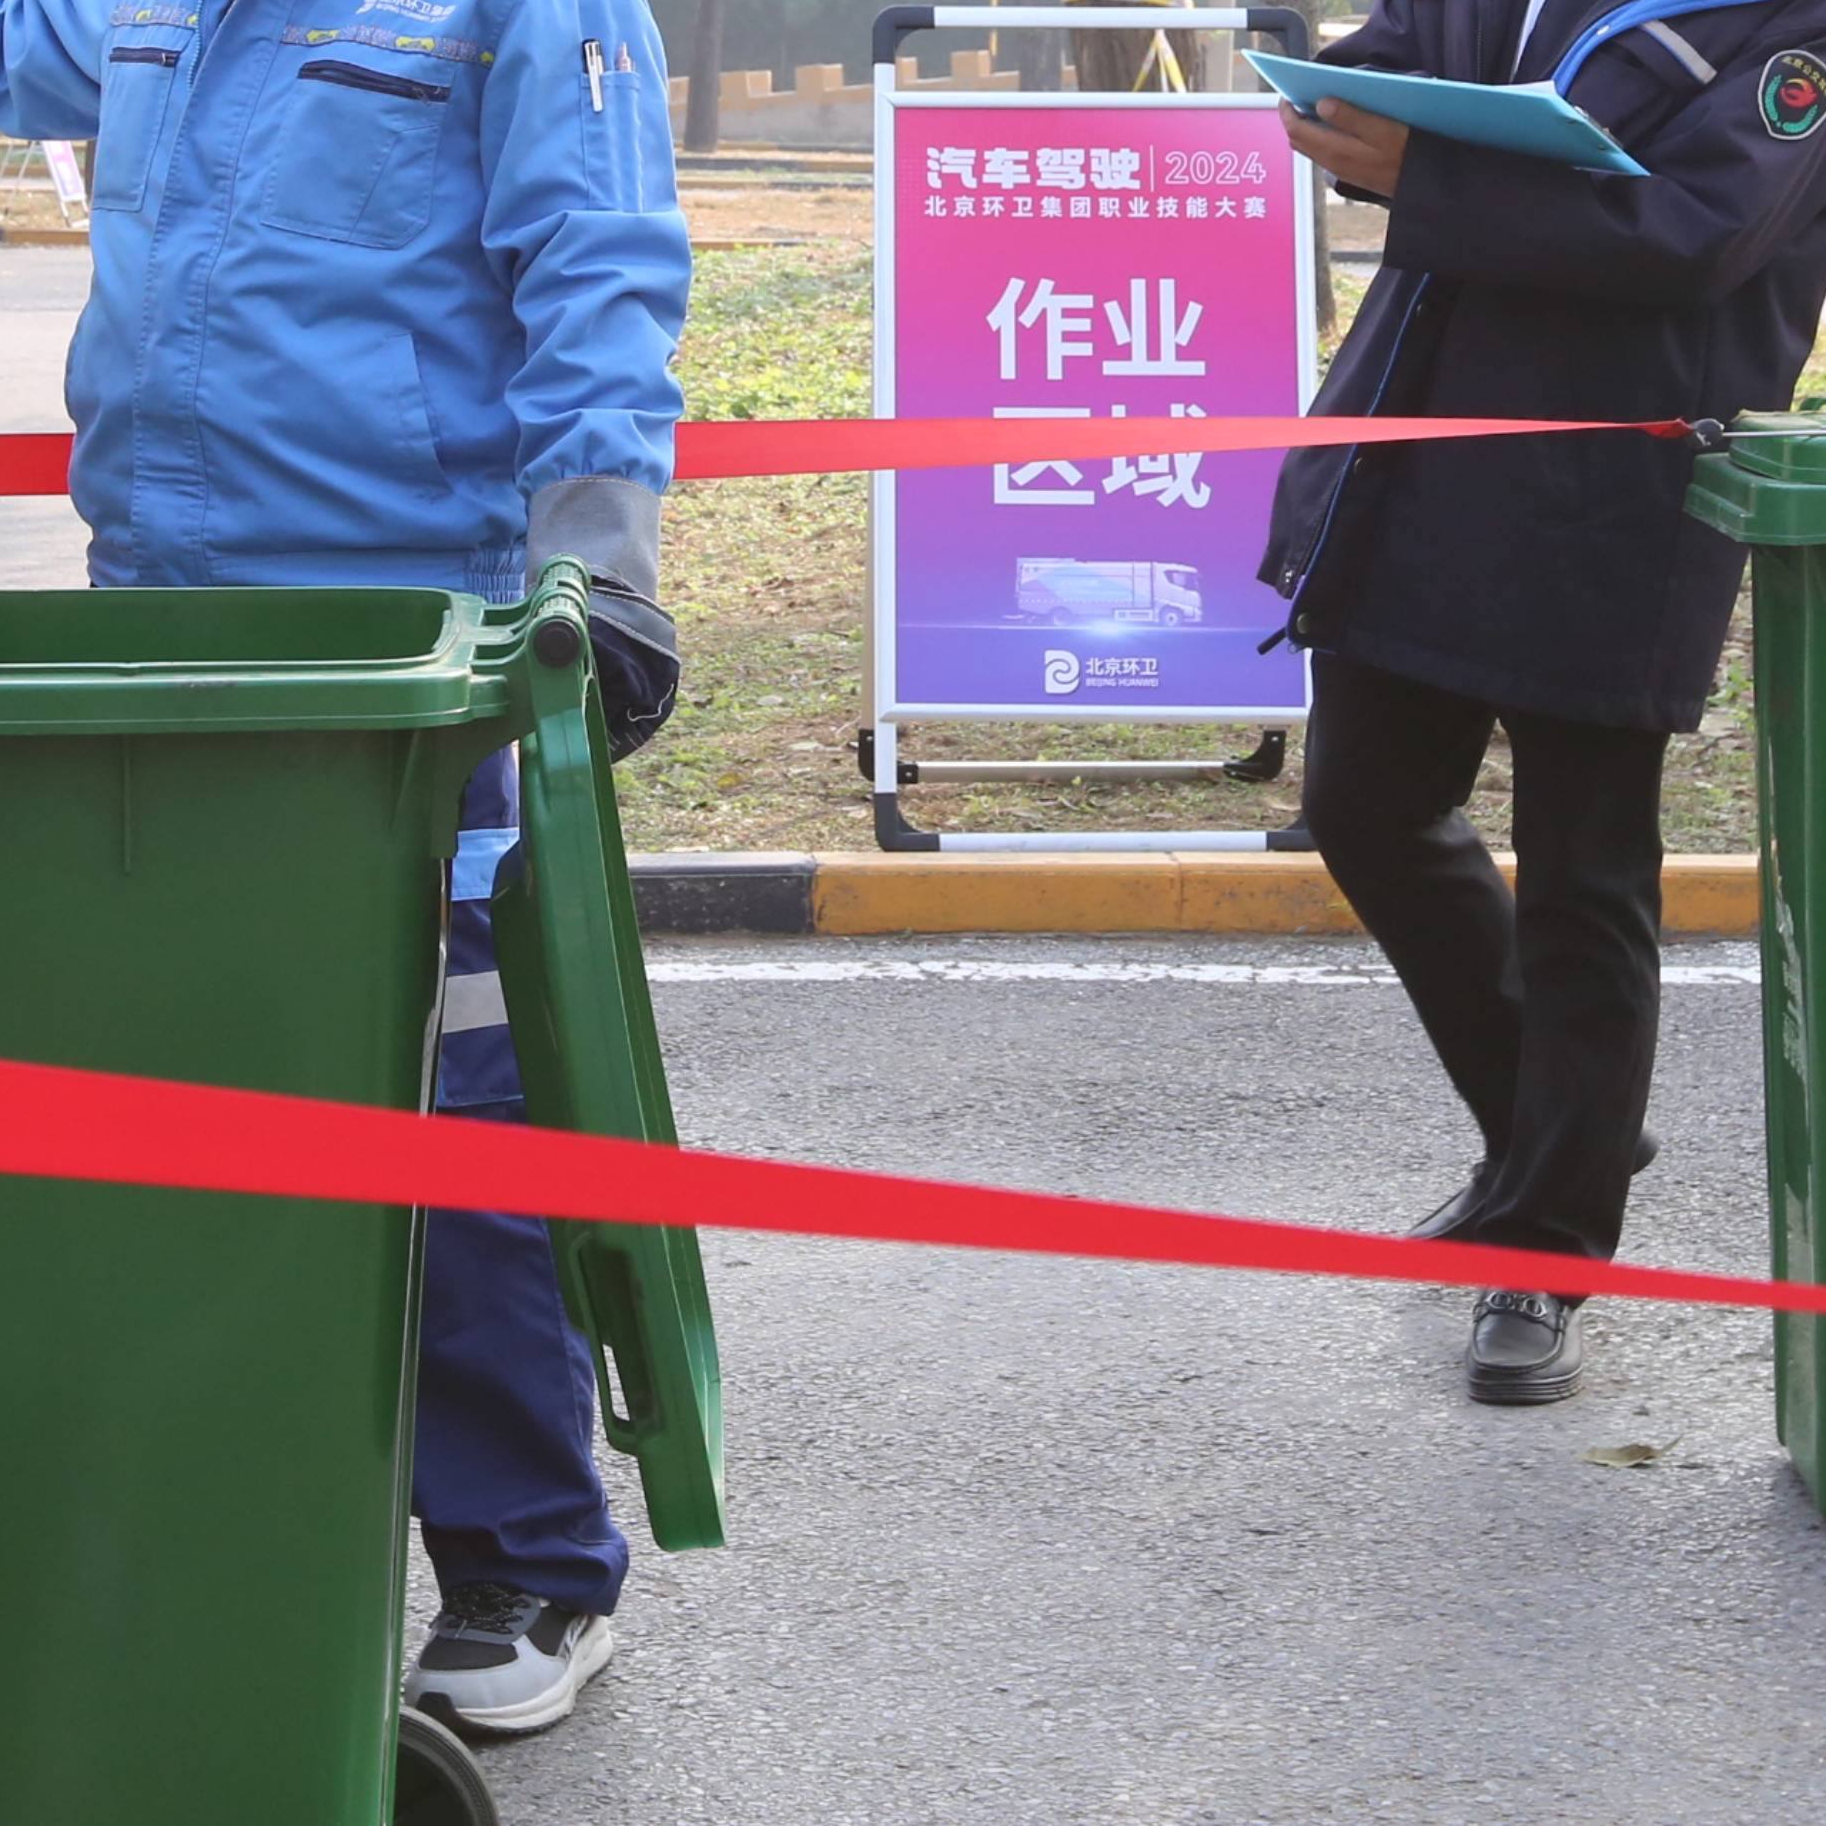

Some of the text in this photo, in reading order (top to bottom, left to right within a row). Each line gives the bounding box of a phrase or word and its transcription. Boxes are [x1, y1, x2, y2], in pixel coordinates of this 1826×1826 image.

[926, 147, 1267, 190] 汽车驾驶 2024
[924, 195, 1267, 219] 北京环卫集团职业技能大赛
[986, 277, 1206, 380] 作业
[1085, 657, 1159, 676] 北京环卫
